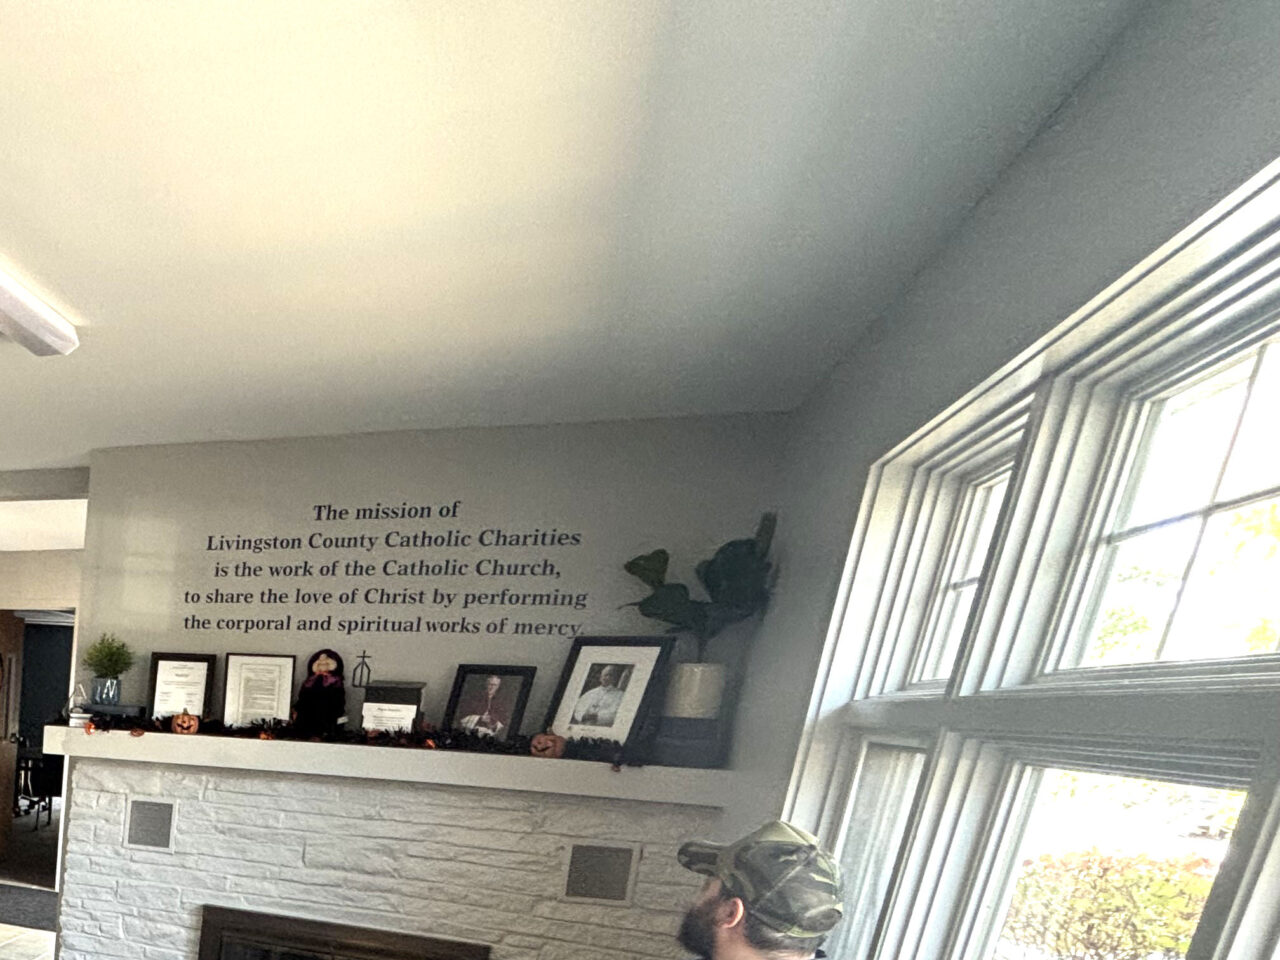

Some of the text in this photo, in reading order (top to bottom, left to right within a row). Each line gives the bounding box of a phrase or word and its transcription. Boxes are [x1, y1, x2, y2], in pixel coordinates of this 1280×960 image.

[314, 501, 461, 521] The mission of
[206, 529, 581, 553] Livingston County Catholic Charities
[215, 559, 560, 578] is the work of the Catholic Church,
[185, 588, 588, 610] to share the love of Christ by performing
[184, 615, 211, 629] the
[217, 615, 291, 633] corporal
[297, 616, 331, 631] and
[338, 616, 421, 635] spiritual
[426, 617, 481, 633] works
[486, 617, 508, 633] of
